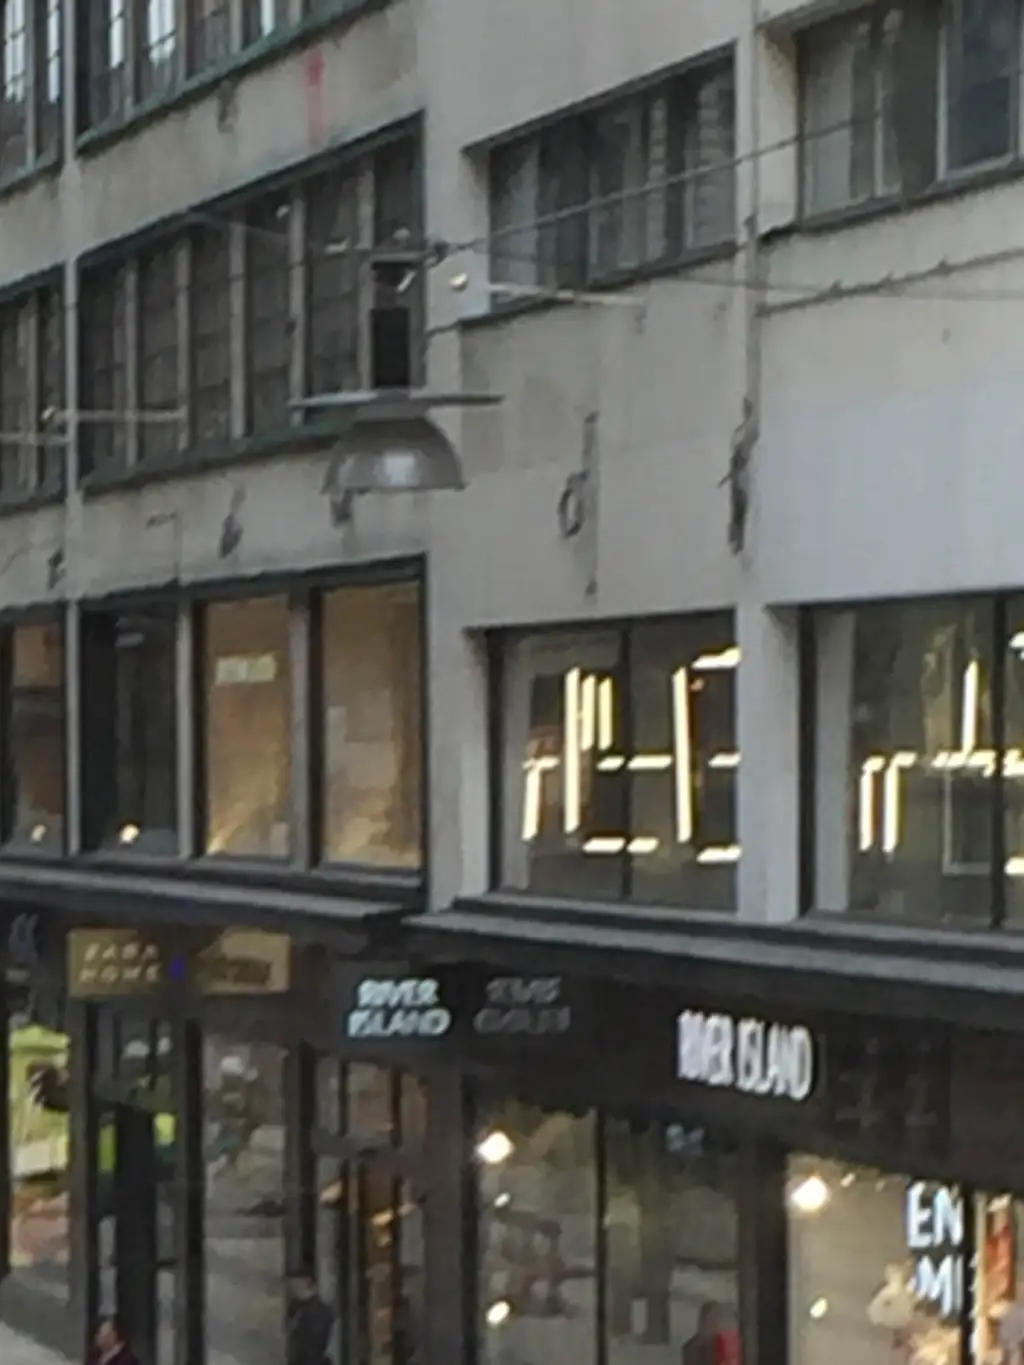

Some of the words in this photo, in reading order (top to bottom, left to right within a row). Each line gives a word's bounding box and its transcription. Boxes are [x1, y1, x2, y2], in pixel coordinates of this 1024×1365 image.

[357, 978, 439, 1006] RIVER
[347, 1007, 452, 1038] ISLAND
[677, 1009, 734, 1087] RIVER
[734, 1016, 813, 1102] ISLAND
